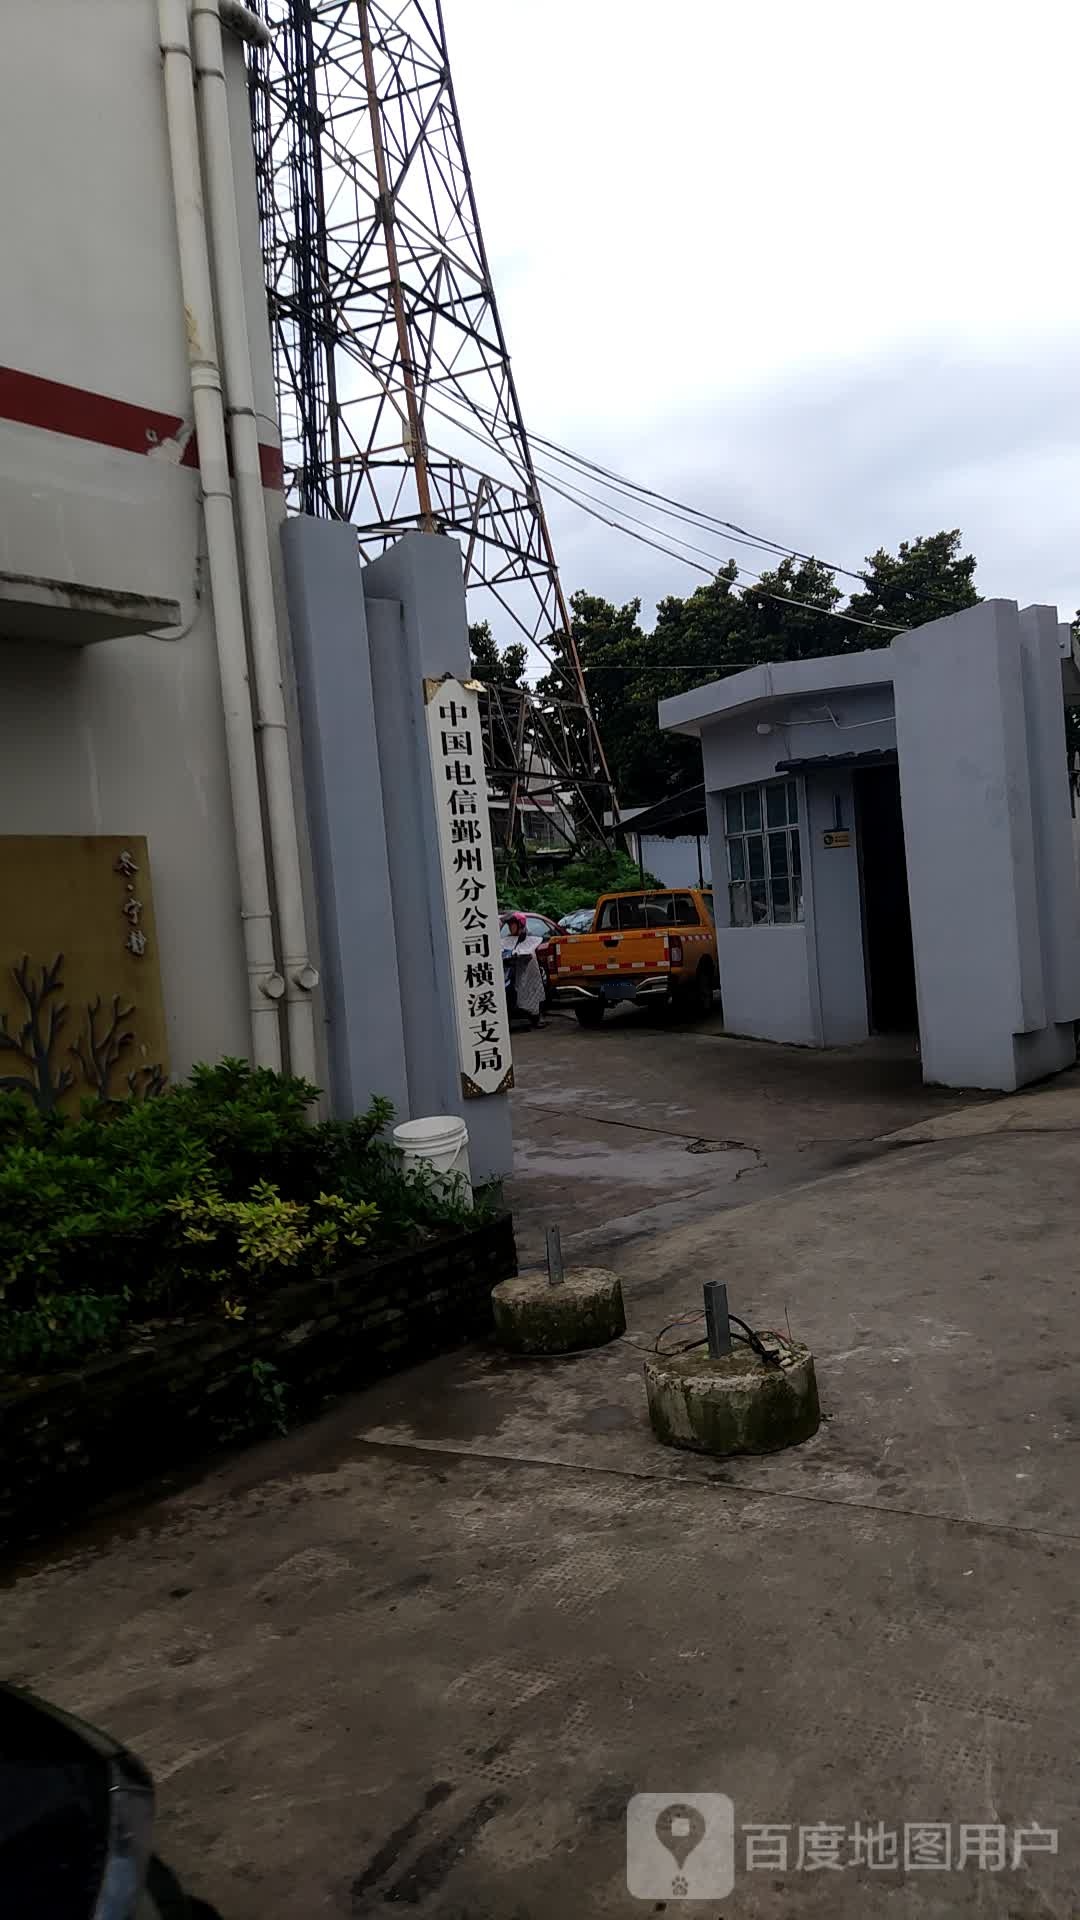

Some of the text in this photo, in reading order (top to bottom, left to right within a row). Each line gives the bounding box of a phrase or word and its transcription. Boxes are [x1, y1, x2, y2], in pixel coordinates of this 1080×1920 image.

[439, 701, 502, 1075] 中国电信鄞州分公司横溪支局
